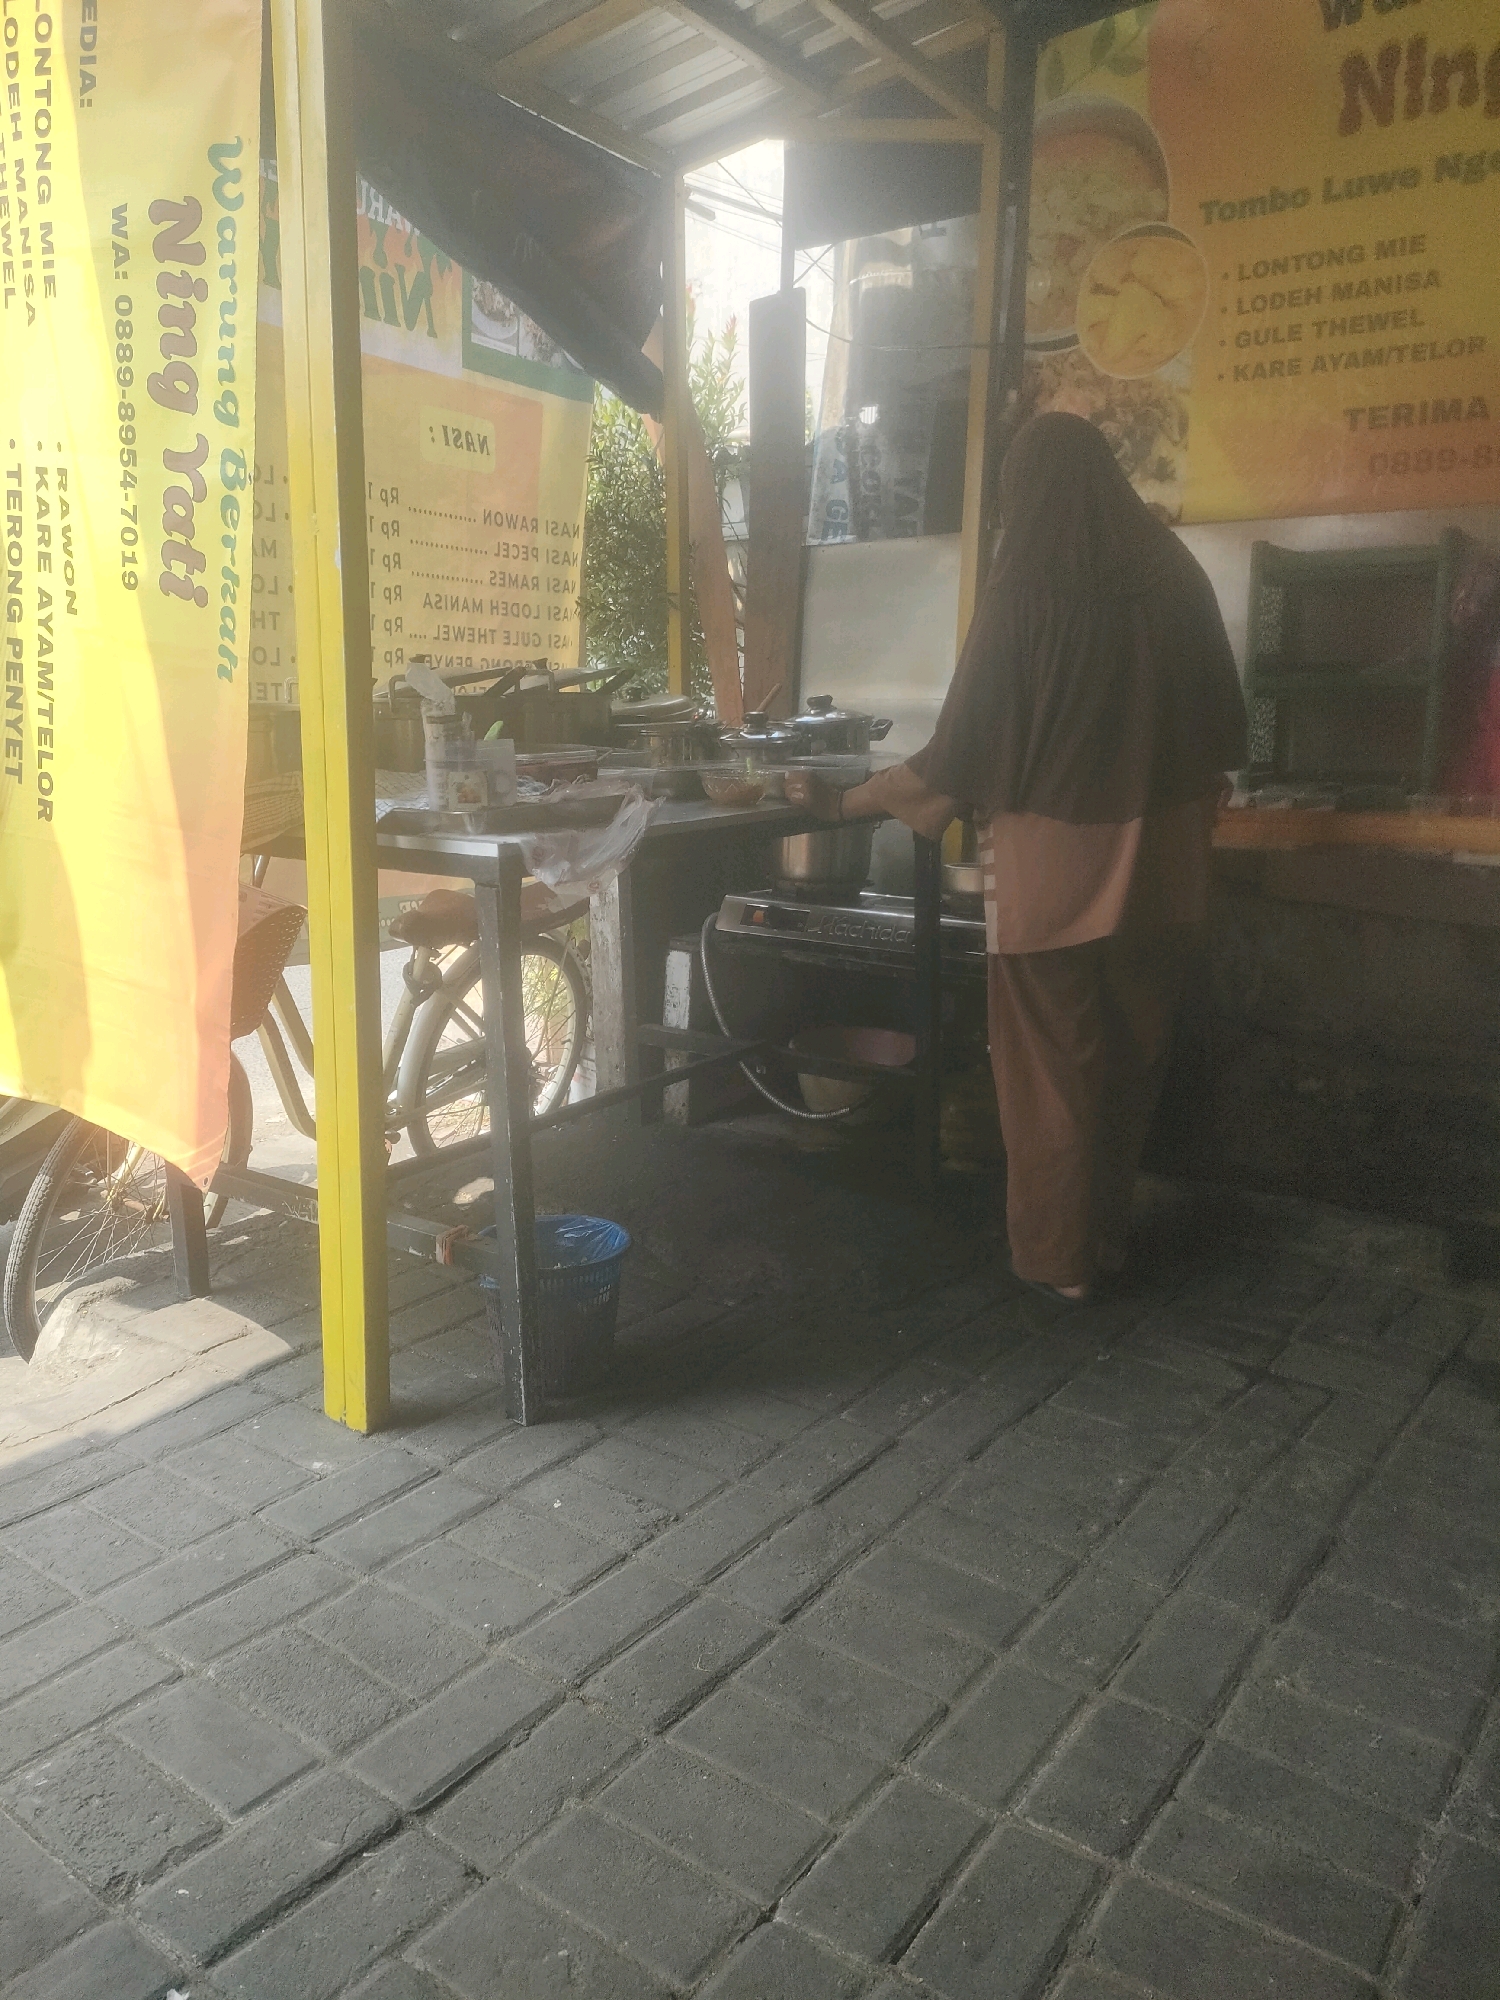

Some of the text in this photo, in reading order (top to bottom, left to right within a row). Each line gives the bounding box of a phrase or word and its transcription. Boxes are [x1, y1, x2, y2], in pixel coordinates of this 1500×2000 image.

[14, 157, 36, 328] MANISA
[1198, 185, 1312, 225] Tombo
[1322, 166, 1423, 204] Luwe
[39, 221, 57, 299] MIE
[1237, 234, 1428, 282] LONTONG MIE
[1237, 269, 1441, 316] LODEH MANISA
[1233, 357, 1302, 382] KARE
[1234, 308, 1426, 350] GULE THEWEL
[111, 202, 139, 591] WA: 0889-8954-7019
[147, 195, 210, 609] Ning Yati
[207, 136, 247, 683] Warung Berkah
[1343, 396, 1490, 431] TERIMA
[56, 467, 78, 615] RAWON
[4, 462, 24, 784] TERONG PENYET
[35, 466, 55, 822] KARE AYAM/TELOR
